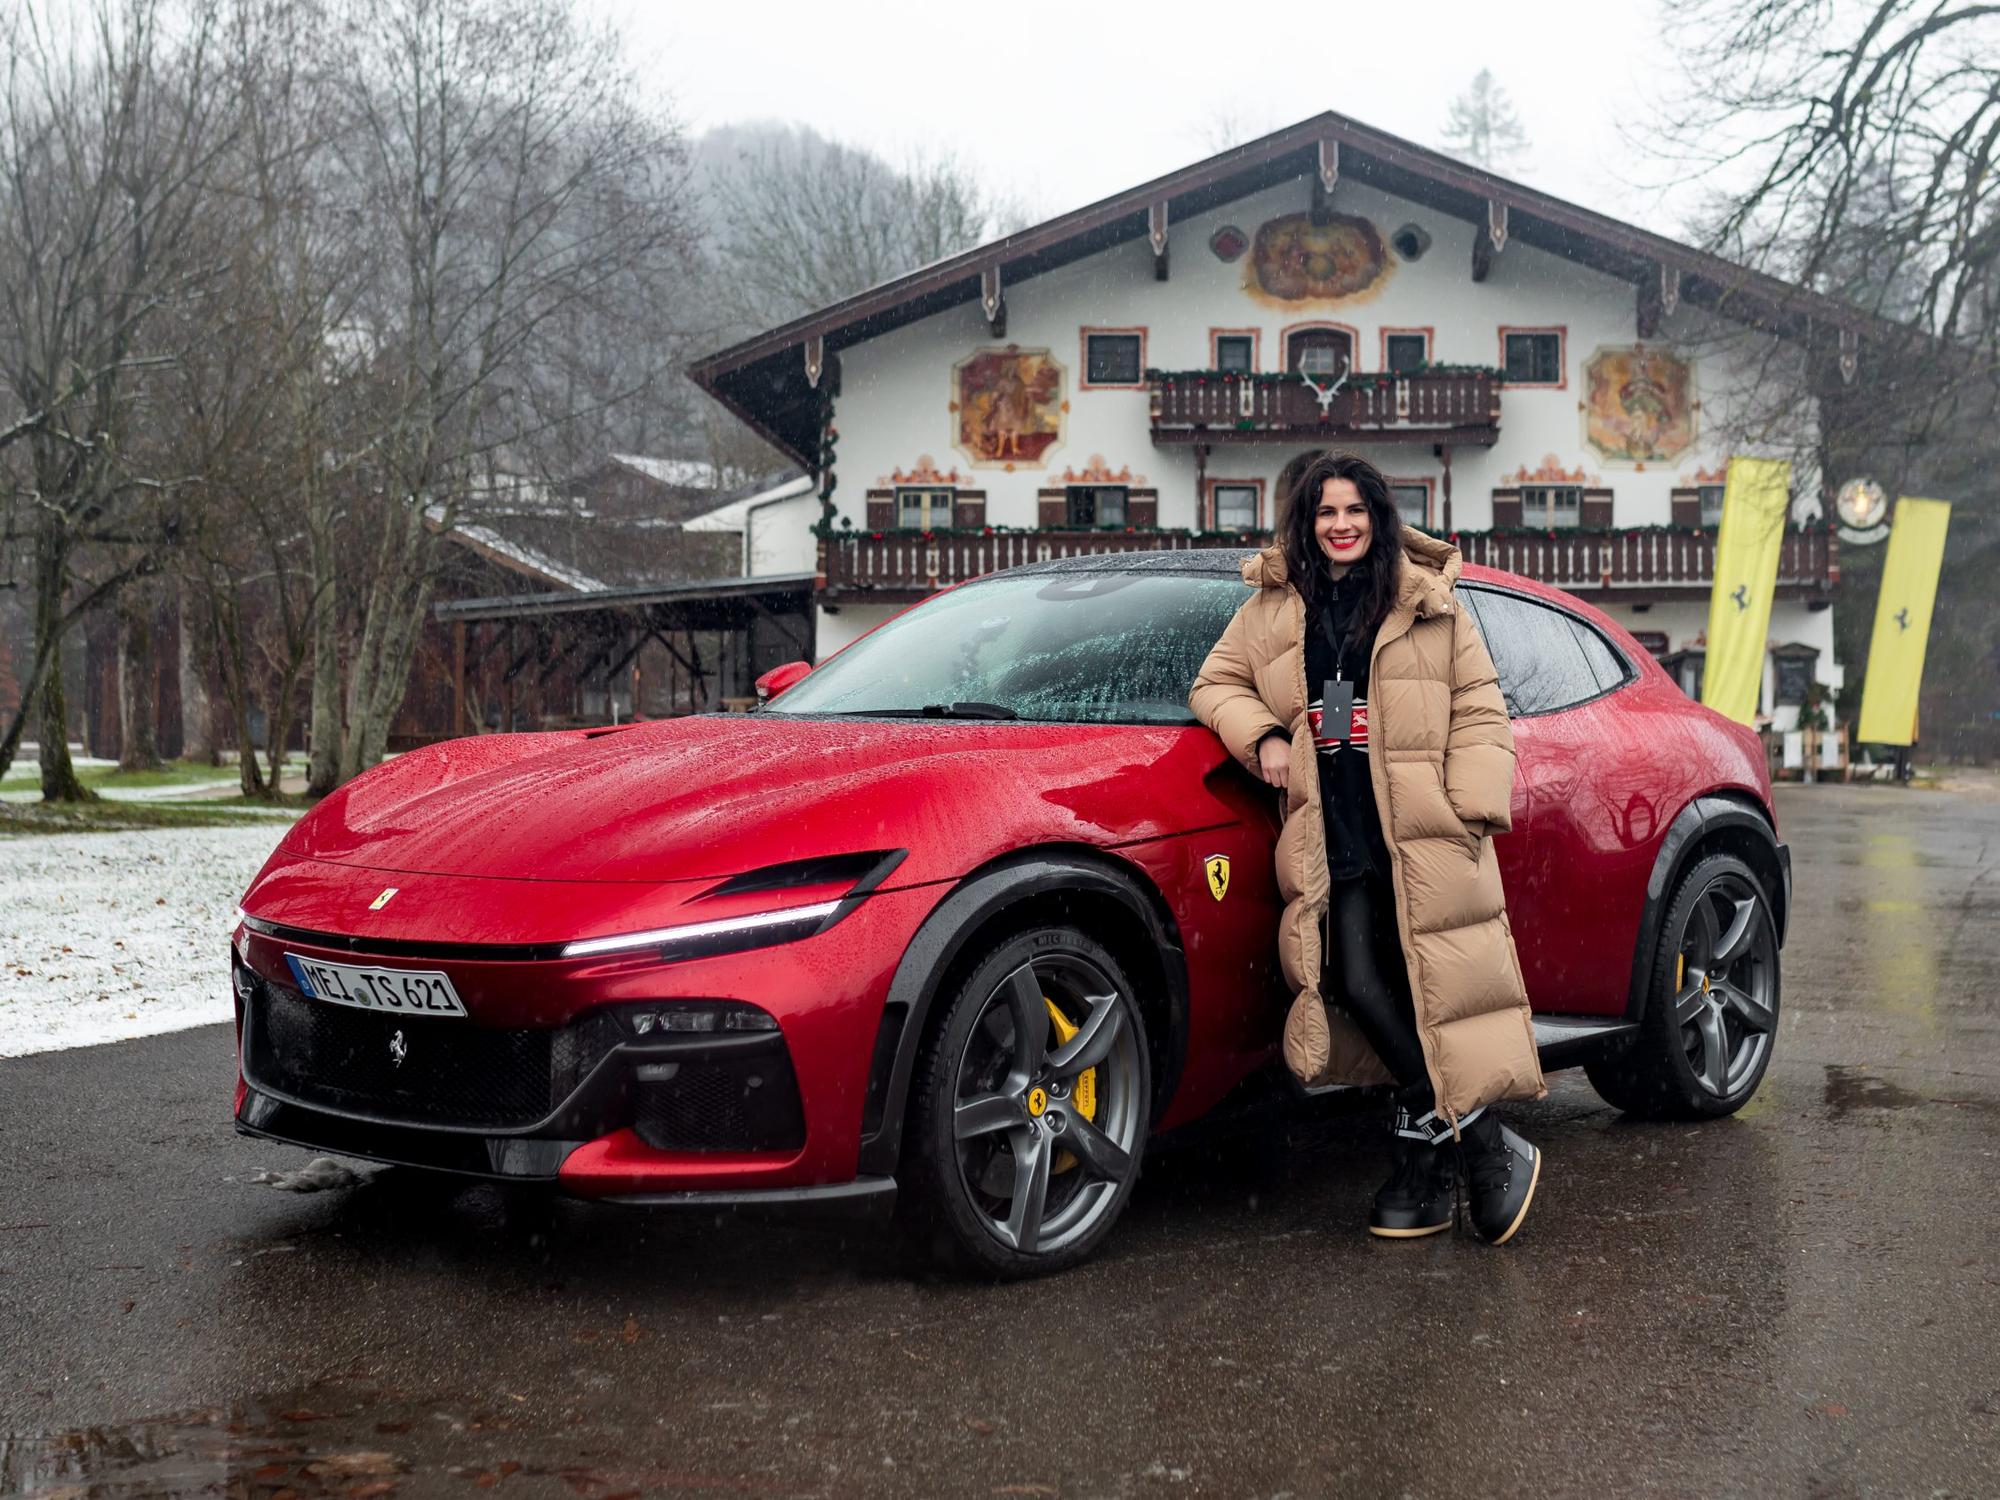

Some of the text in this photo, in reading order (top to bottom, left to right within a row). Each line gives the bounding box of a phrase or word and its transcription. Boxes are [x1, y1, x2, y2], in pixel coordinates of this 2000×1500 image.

[303, 964, 459, 1011] MEI TS 621
